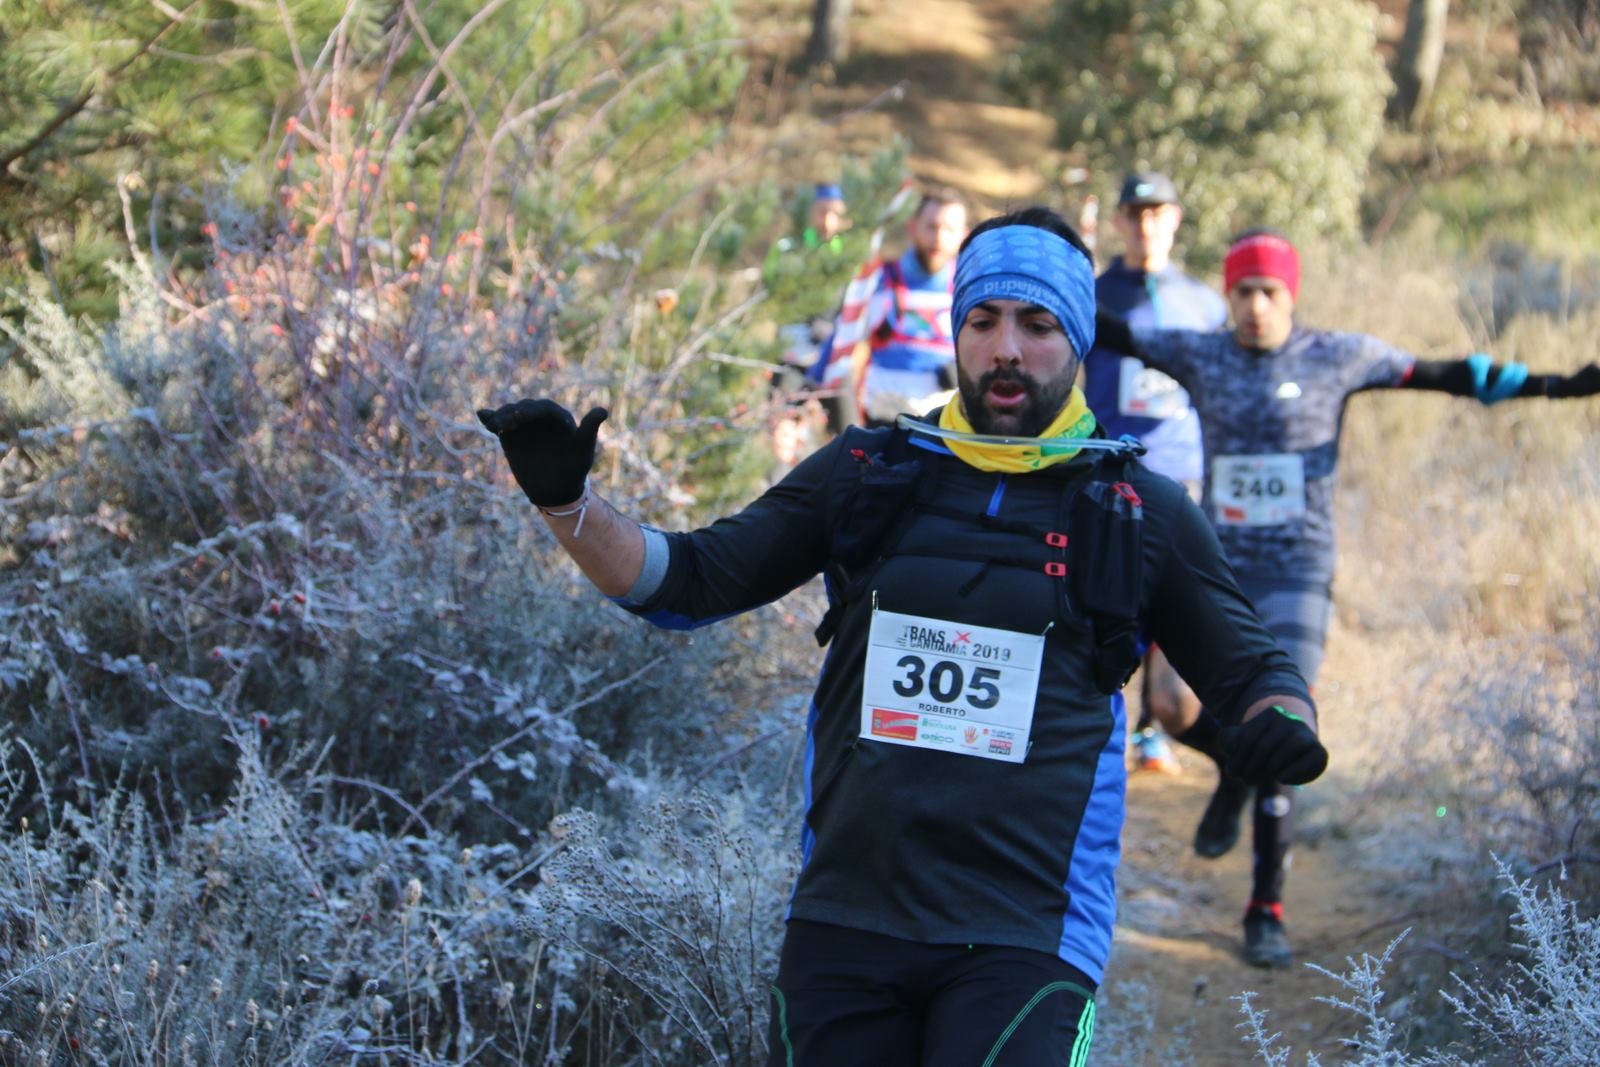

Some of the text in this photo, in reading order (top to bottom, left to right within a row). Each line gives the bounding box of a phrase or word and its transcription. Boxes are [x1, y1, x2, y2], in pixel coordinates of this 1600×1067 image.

[1231, 477, 1285, 497] 240
[973, 643, 1011, 662] 2019
[893, 655, 1001, 710] 305
[918, 703, 966, 717] ROBERTO
